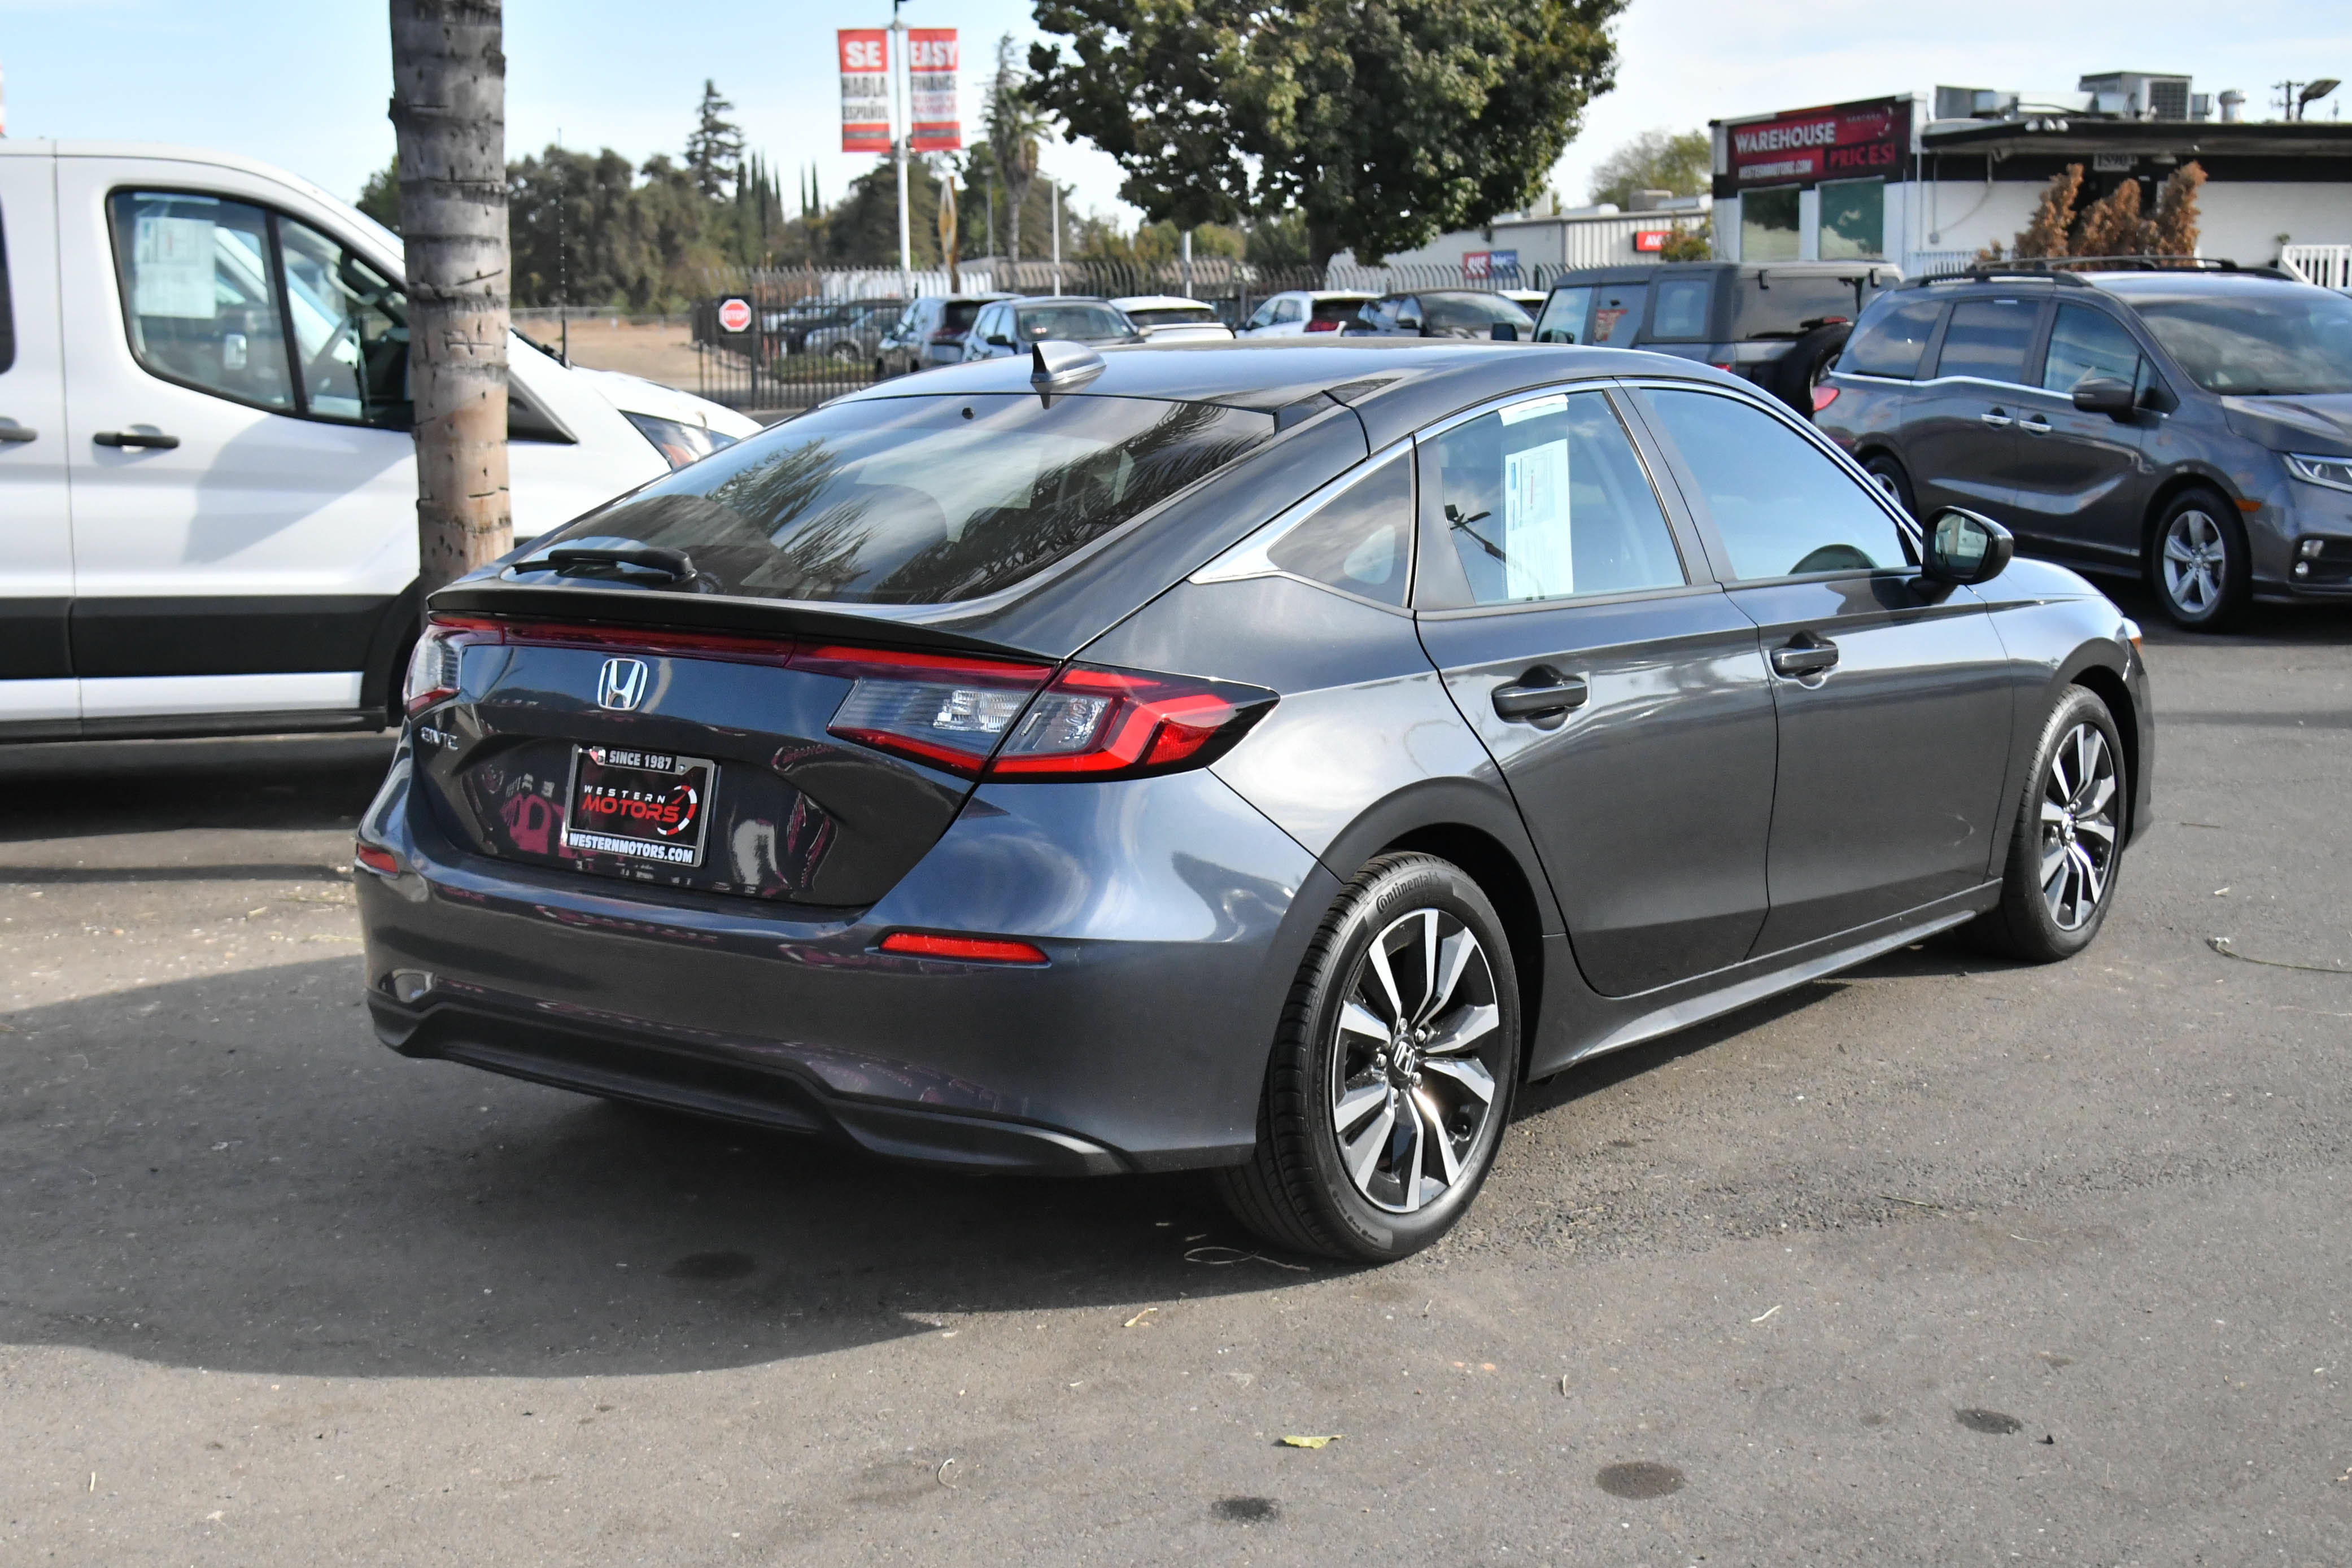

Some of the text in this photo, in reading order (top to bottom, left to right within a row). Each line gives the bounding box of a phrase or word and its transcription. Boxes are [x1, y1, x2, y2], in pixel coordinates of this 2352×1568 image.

[845, 41, 882, 68] SE
[910, 41, 958, 67] EASY
[1734, 121, 1836, 154] WAREHOUSE
[724, 310, 748, 321] STOP
[609, 750, 672, 770] SINCE 1987
[584, 784, 666, 804] WESTERN
[582, 794, 680, 823] MOTORS
[569, 832, 693, 864] WESTERNMOTORS.COM
[1376, 871, 1433, 914] Continental
